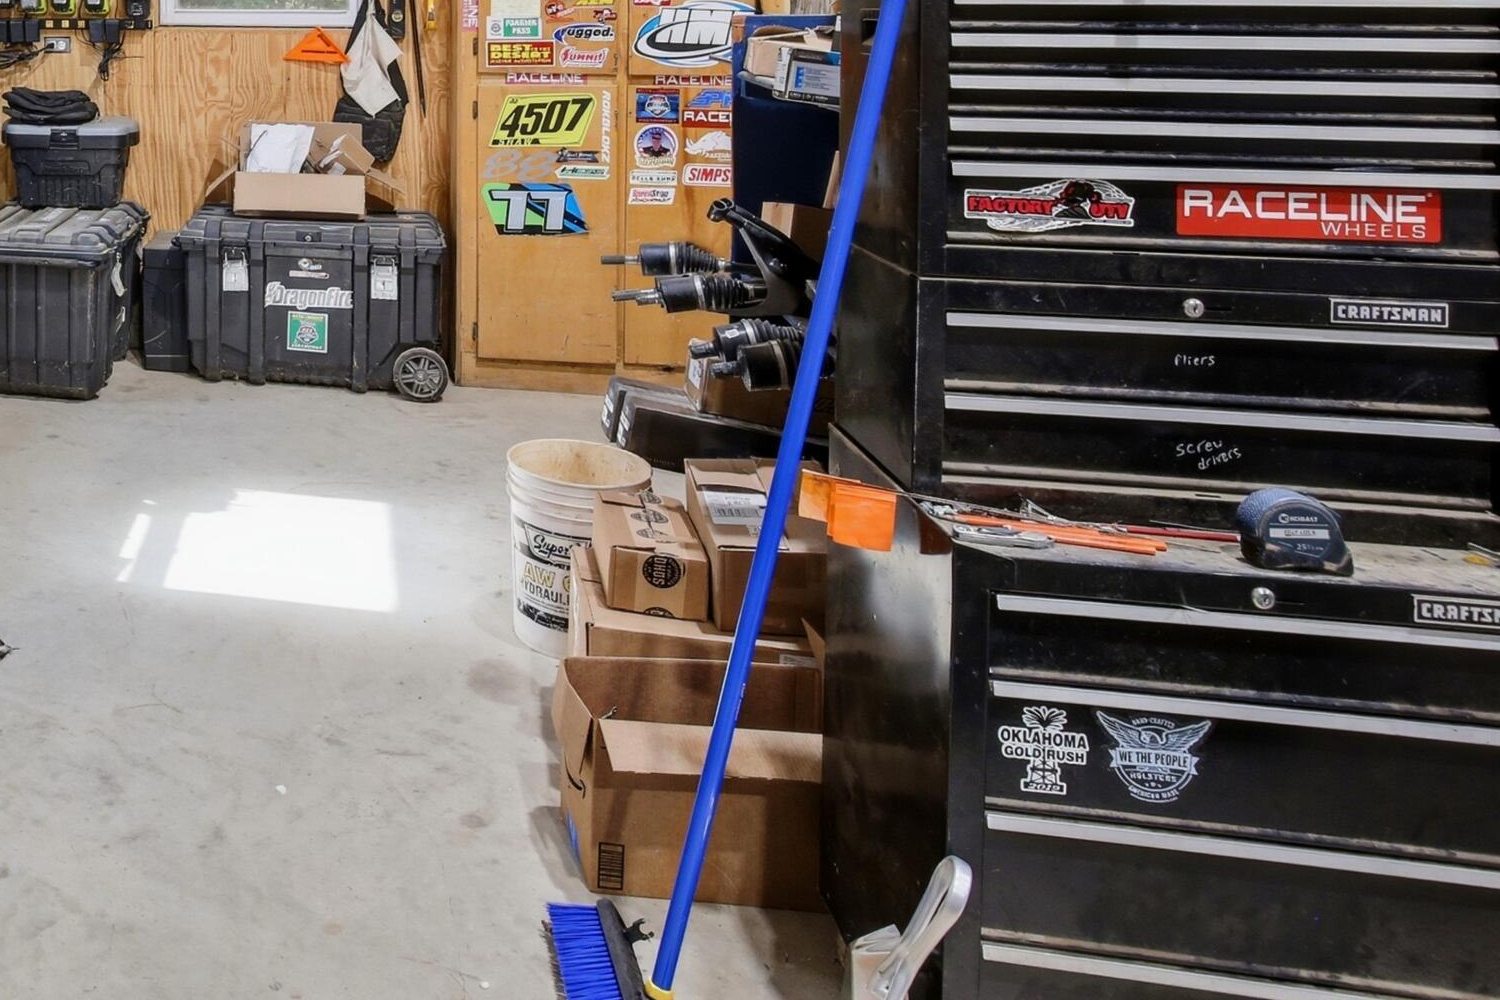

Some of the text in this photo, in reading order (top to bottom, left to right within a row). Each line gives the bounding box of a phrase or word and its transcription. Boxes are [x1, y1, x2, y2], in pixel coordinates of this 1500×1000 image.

[500, 98, 593, 138] 4507
[684, 111, 732, 122] RACE
[689, 167, 731, 181] SIMPS
[490, 189, 571, 231] 77
[967, 196, 1053, 215] FACTORY
[1183, 189, 1427, 224] RACELINE
[1320, 221, 1427, 240] WHEELS
[1336, 303, 1442, 323] CRAFTSMAN
[522, 561, 556, 588] AW
[1000, 728, 1087, 749] OKLAHOMA
[1004, 745, 1085, 763] GOLD RUSH
[1119, 750, 1189, 768] WE THE PEOPLE
